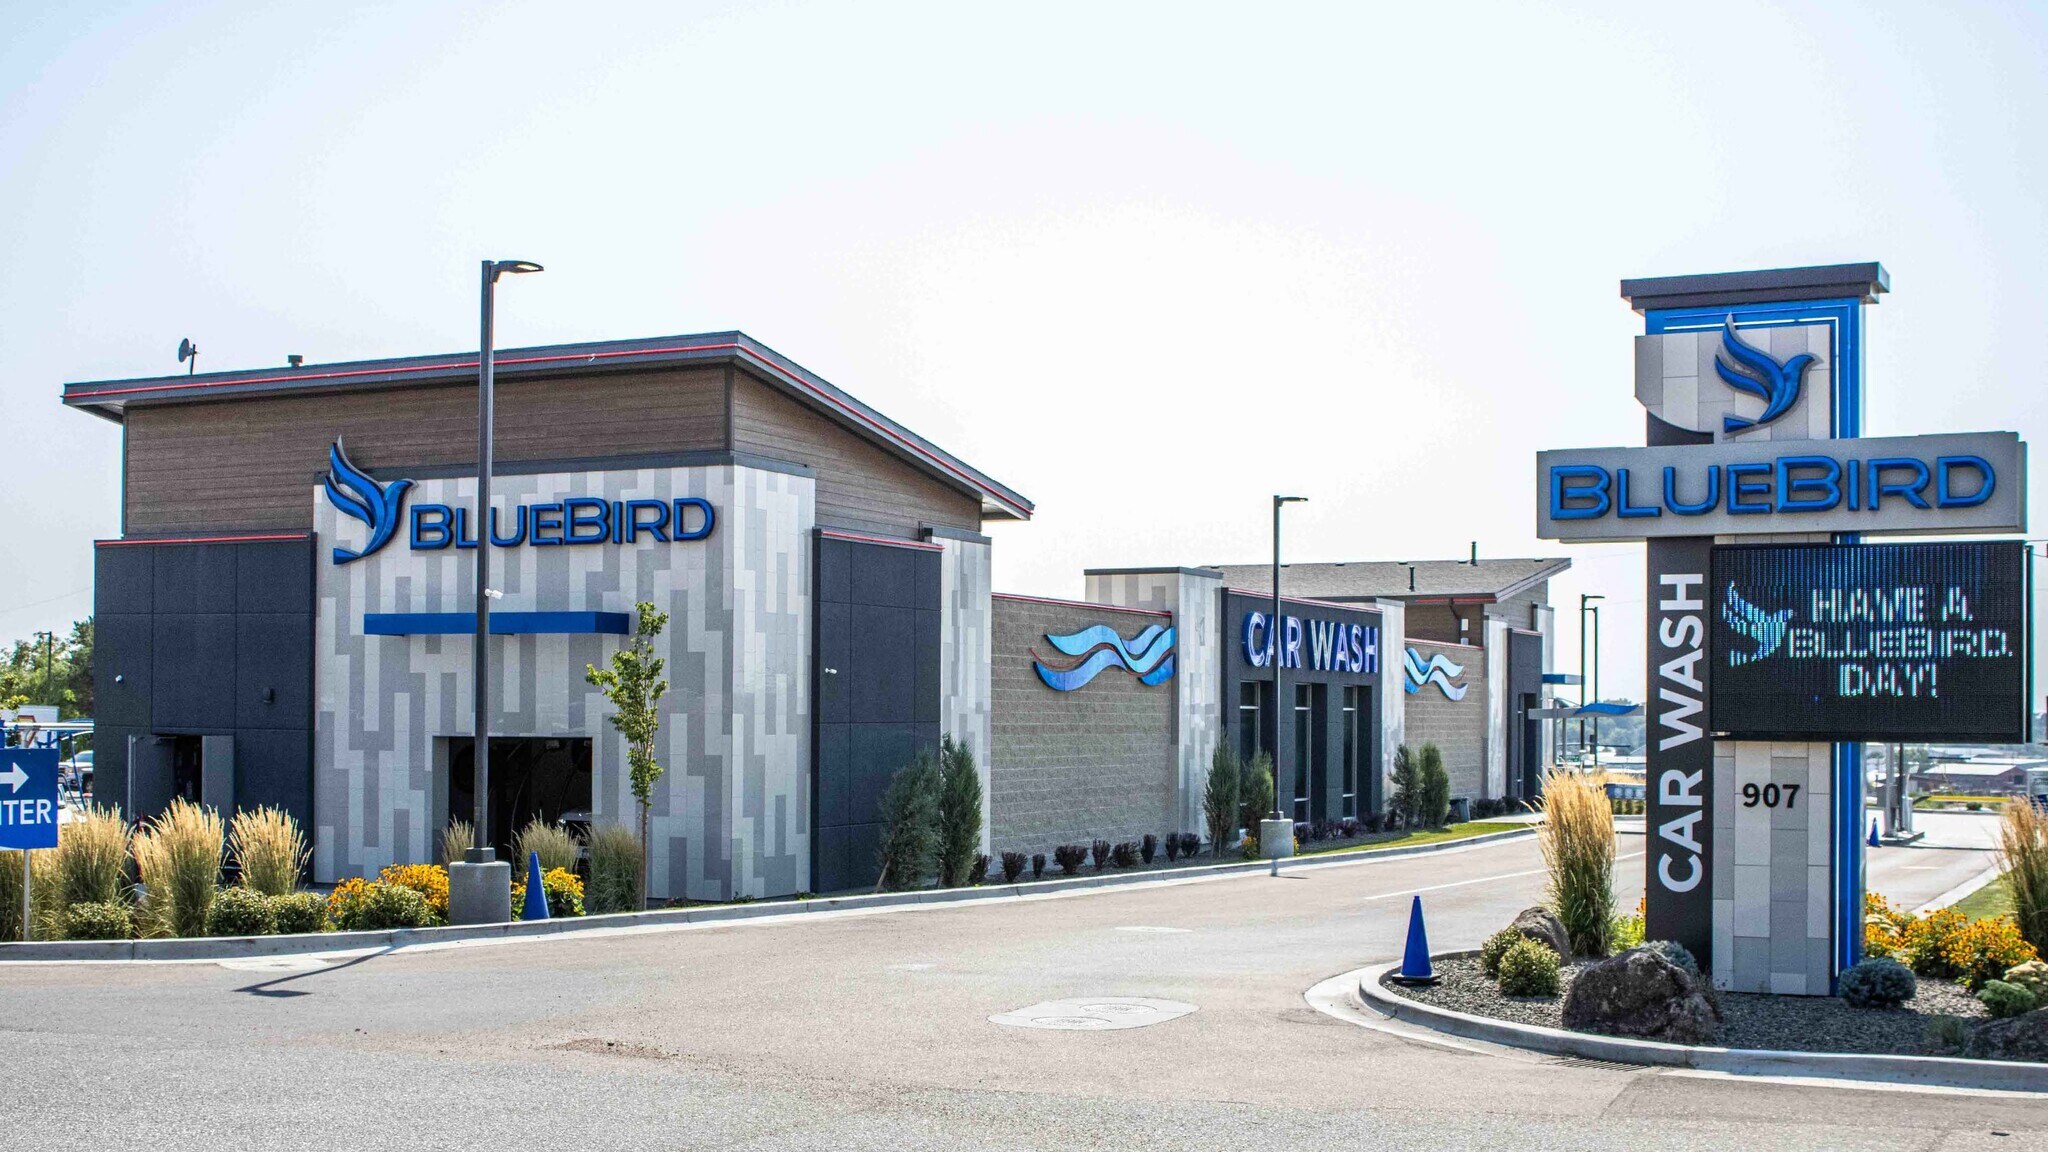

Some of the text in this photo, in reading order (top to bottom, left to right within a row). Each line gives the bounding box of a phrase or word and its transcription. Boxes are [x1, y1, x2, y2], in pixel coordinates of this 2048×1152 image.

[1550, 456, 1996, 520] BLUEBIRD
[410, 497, 715, 550] BLUEBIRD
[1812, 586, 1973, 623] HAVE A
[1242, 611, 1379, 674] CAR WASH
[1788, 627, 2013, 659] BLUEBIRD
[1839, 662, 1938, 698] DAY!
[1658, 573, 1704, 893] CAR WASH
[0, 799, 52, 826] TER
[1742, 782, 1801, 809] 907
